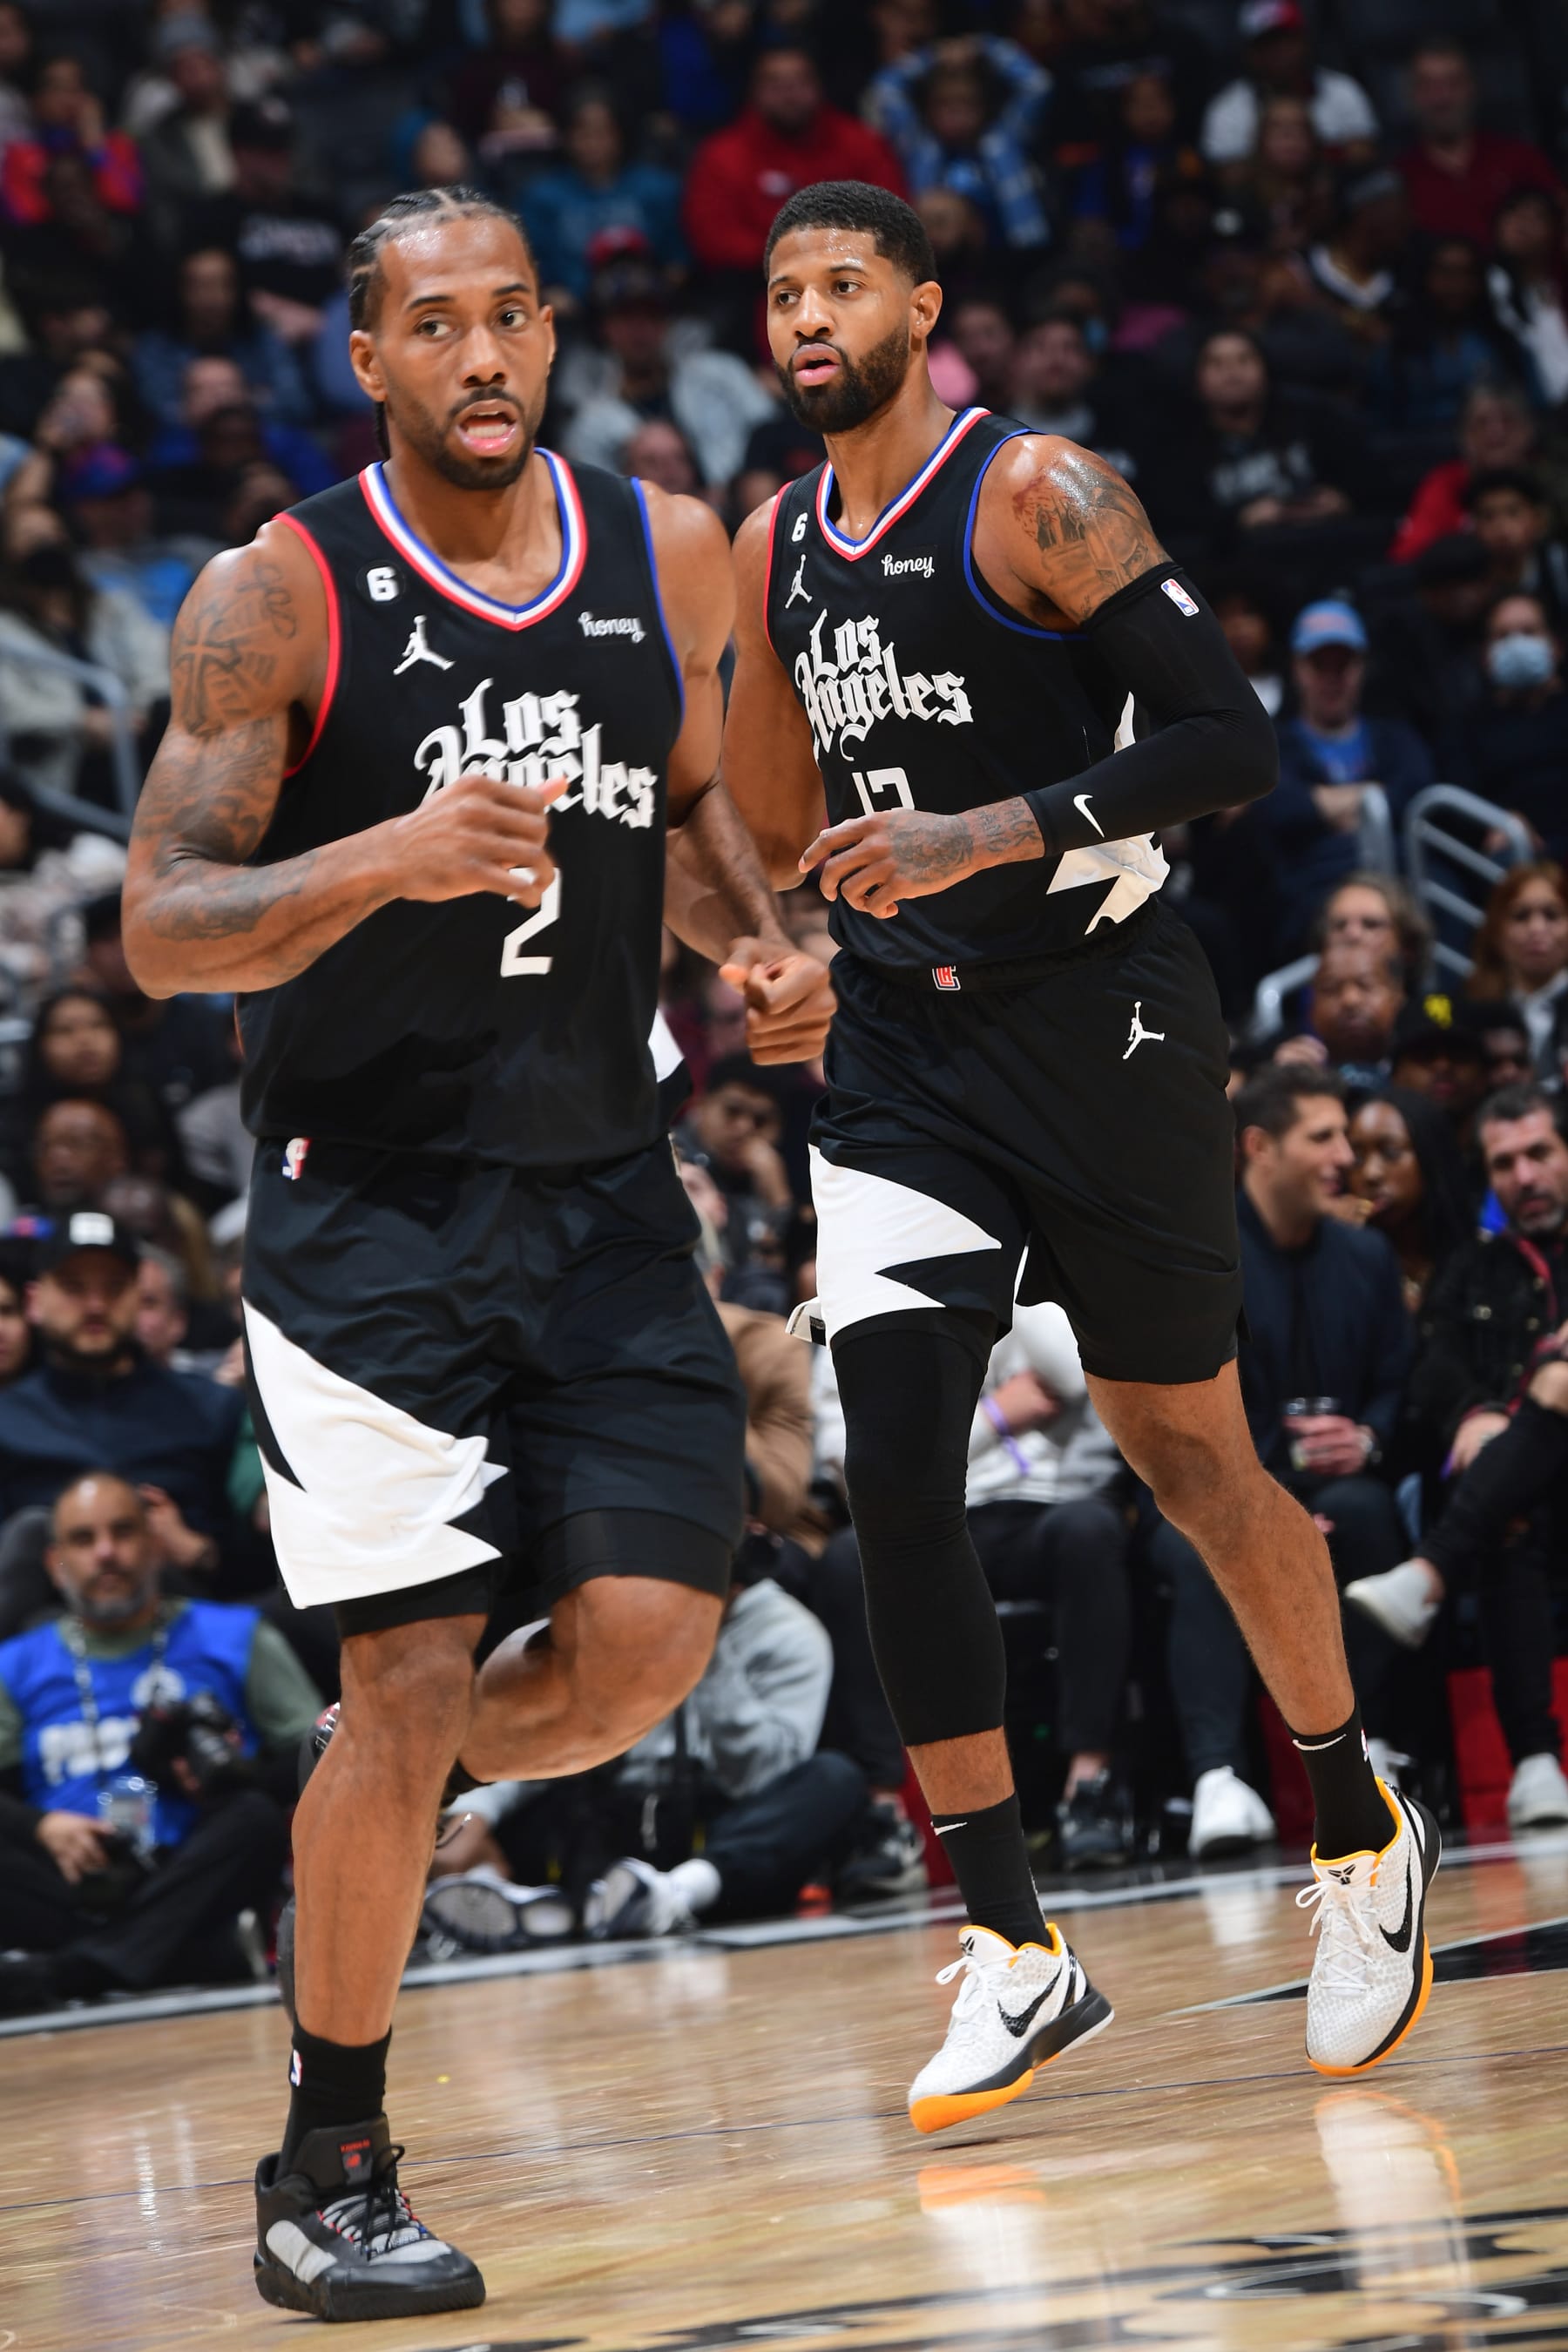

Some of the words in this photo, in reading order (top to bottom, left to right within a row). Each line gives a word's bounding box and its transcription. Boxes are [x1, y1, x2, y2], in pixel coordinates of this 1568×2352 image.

[791, 512, 808, 542] 6
[366, 566, 399, 601] 6
[881, 554, 935, 578] honey
[578, 611, 645, 643] honey
[809, 608, 883, 685] Los
[458, 677, 583, 765] Los
[794, 641, 974, 772] Angeles
[500, 866, 561, 977] 2
